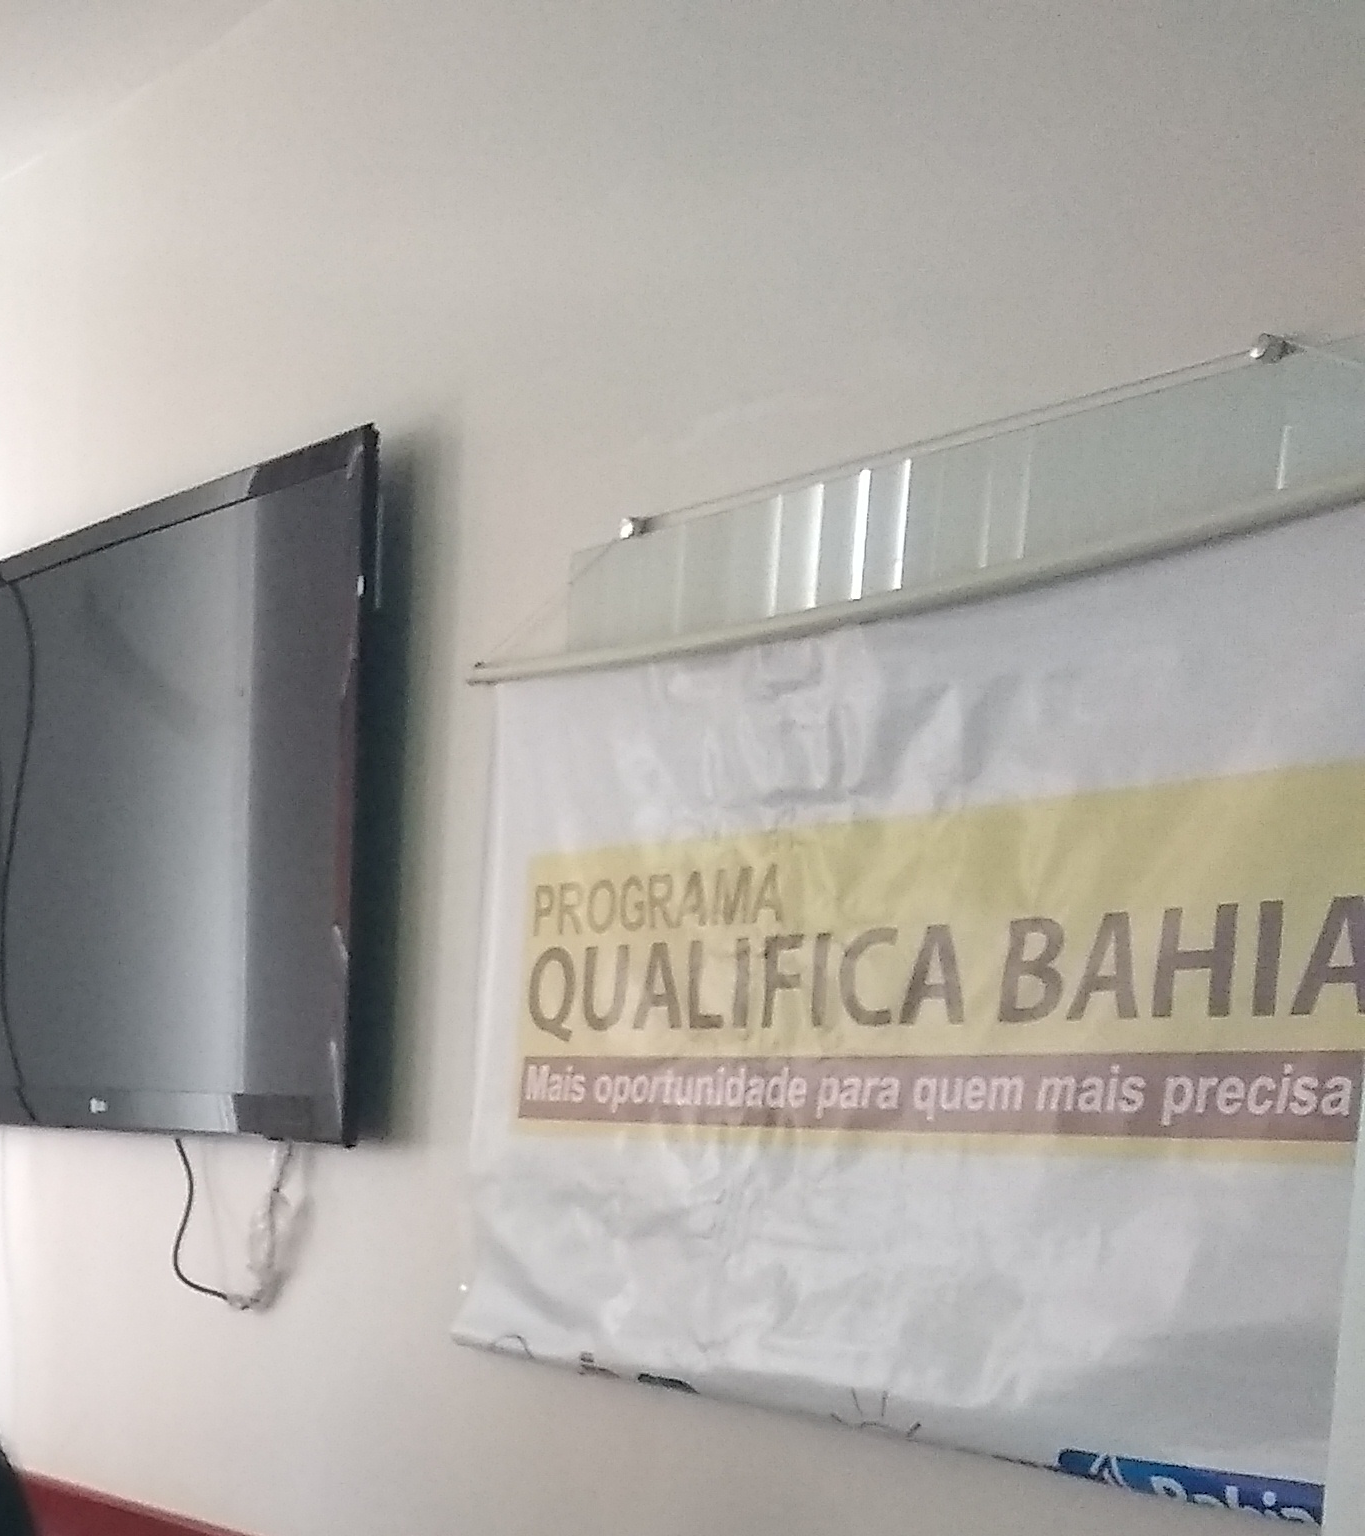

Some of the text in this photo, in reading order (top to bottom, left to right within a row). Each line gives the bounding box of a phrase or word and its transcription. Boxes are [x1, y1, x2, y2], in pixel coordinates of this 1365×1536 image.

[533, 863, 783, 936] PROGRAMA
[528, 895, 1365, 1041] QUALIFICA BAHIA
[525, 1064, 1352, 1126] Mais oportunidade para quem mais precisa
